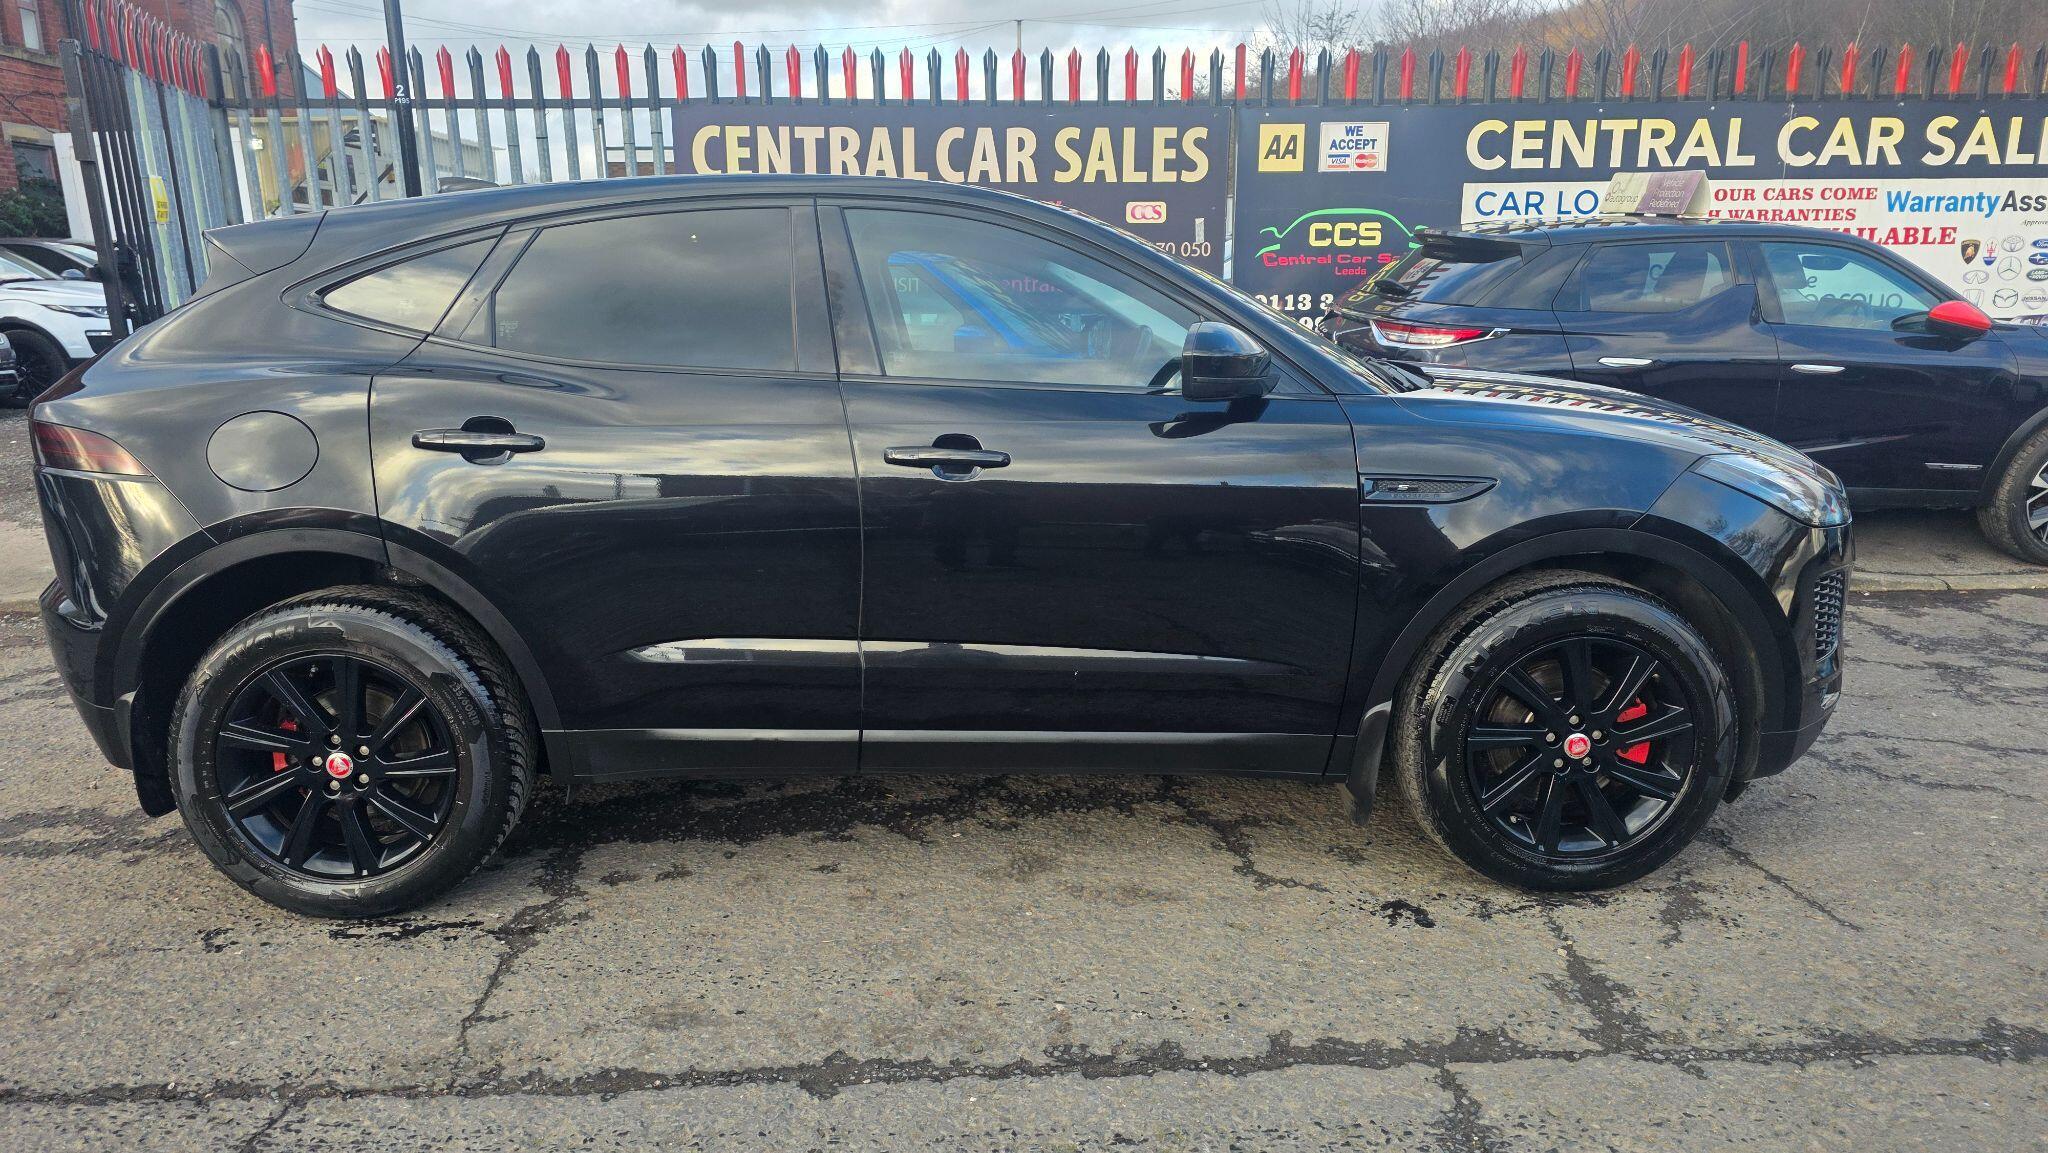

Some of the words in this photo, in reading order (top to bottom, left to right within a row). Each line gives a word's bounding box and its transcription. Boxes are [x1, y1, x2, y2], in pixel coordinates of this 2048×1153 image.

[395, 84, 405, 97] 2
[1344, 125, 1364, 137] WE
[1263, 134, 1299, 160] AA
[1329, 138, 1378, 151] ACCEPT
[1465, 116, 1756, 171] CENTRAL
[1776, 115, 1906, 167] CAR
[691, 124, 929, 180] CENTRAL
[935, 126, 1039, 184] CAR
[1053, 126, 1210, 184] SALES
[1331, 157, 1347, 165] VISA
[1713, 187, 1758, 202] OUR
[1762, 186, 1815, 202] CARS
[1819, 186, 1879, 201] COME
[1474, 190, 1546, 217] CAR
[1556, 188, 1600, 216] LO
[1886, 189, 2048, 218] WarrantyAss
[1130, 204, 1163, 220] CCS
[1727, 207, 1858, 222] WARRANTIES
[1308, 221, 1383, 247] CCS
[1180, 241, 1212, 257] 050
[1262, 252, 1332, 268] Central
[1336, 253, 1373, 265] Car
[1334, 265, 1368, 276] Leeds
